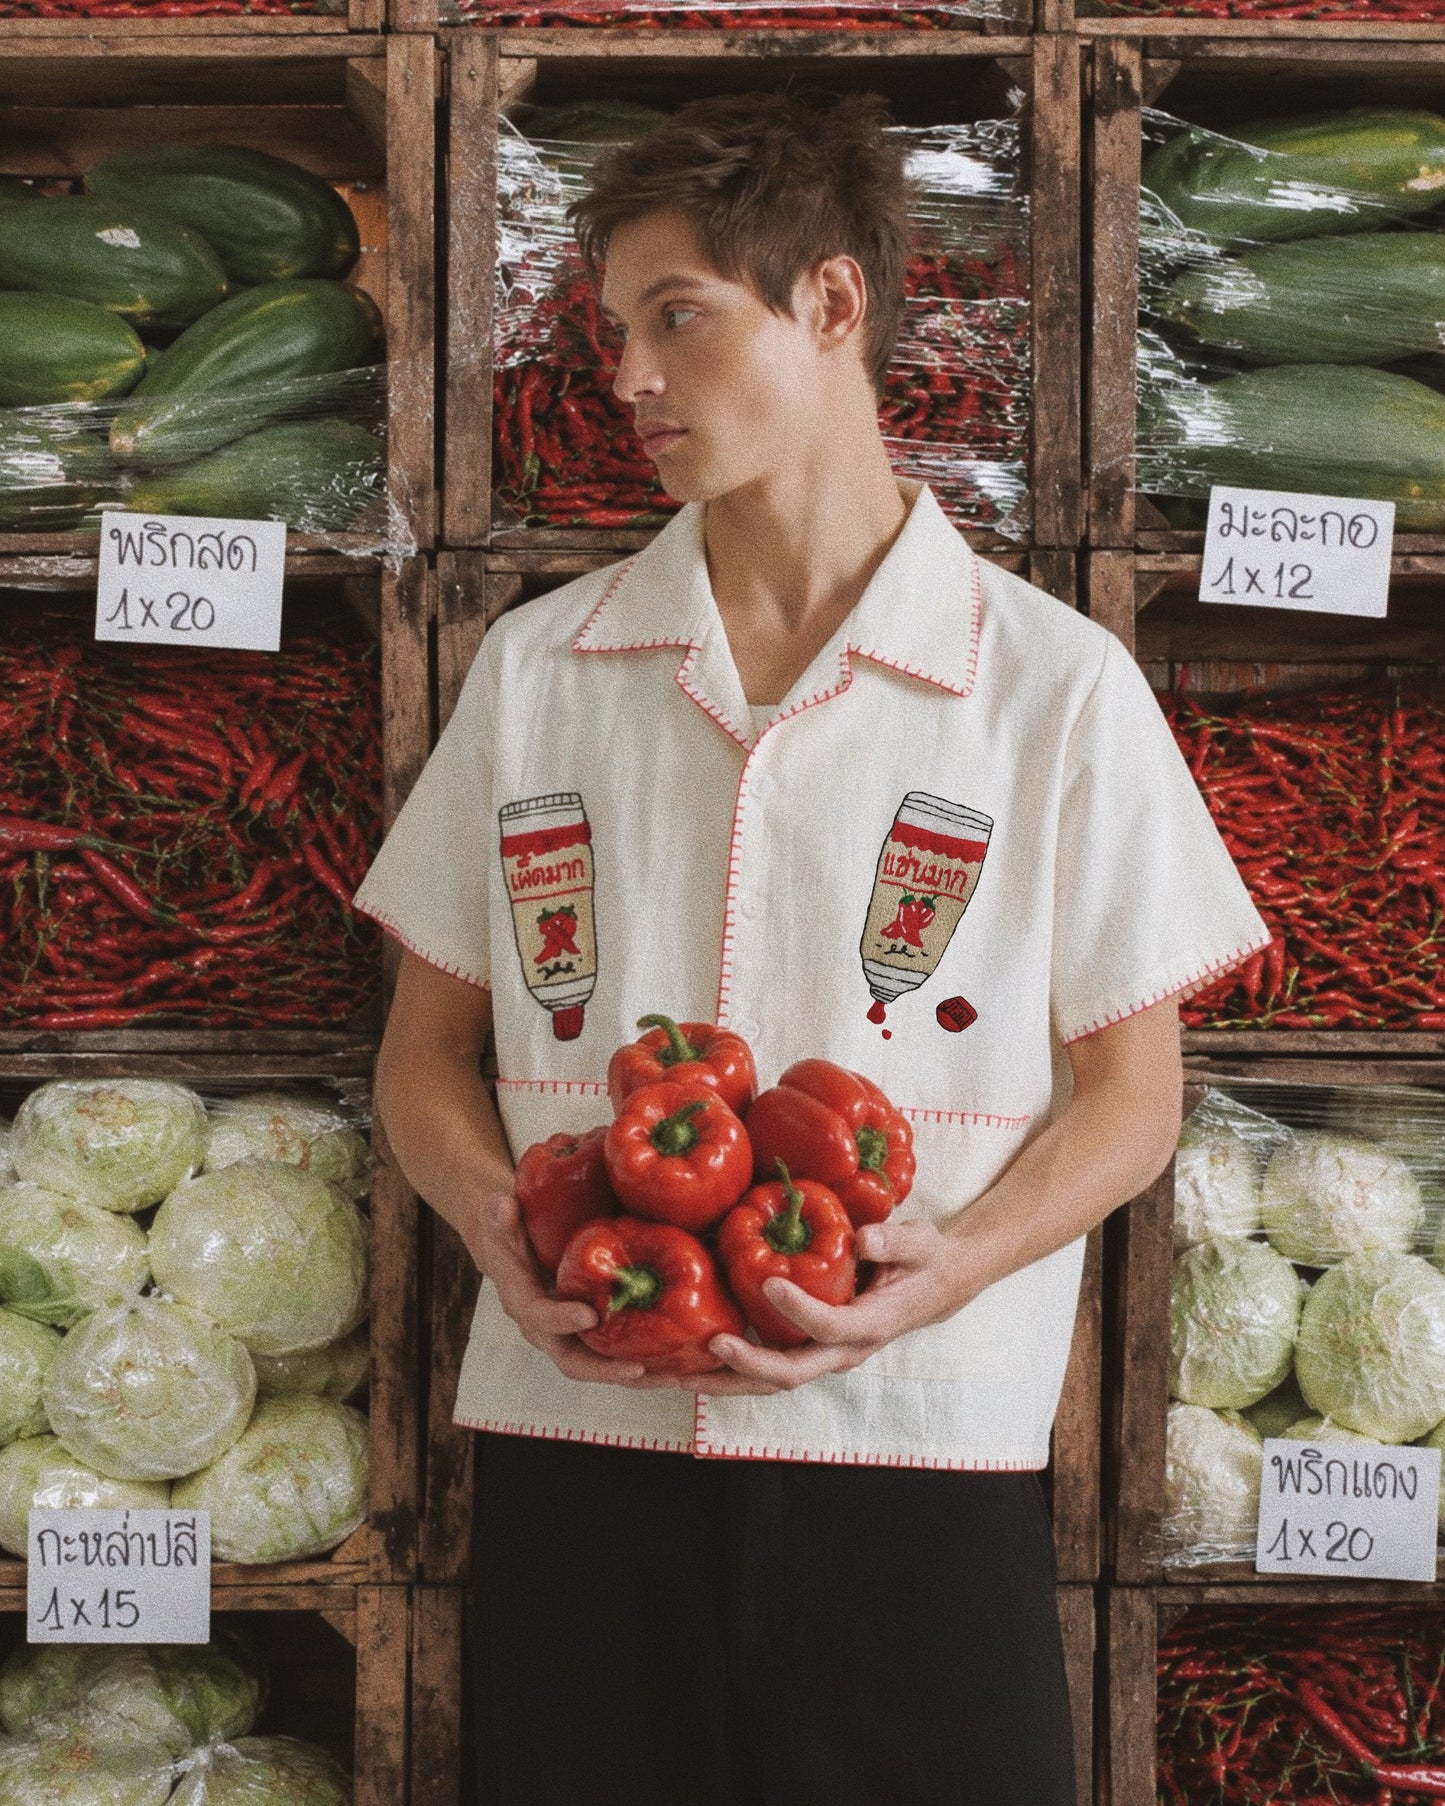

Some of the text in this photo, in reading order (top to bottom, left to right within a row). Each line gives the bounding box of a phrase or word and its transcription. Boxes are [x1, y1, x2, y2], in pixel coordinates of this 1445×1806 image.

[110, 522, 257, 572] พริกสด
[1219, 502, 1378, 549] มะละกอ
[1271, 1449, 1418, 1500] พริกแดง
